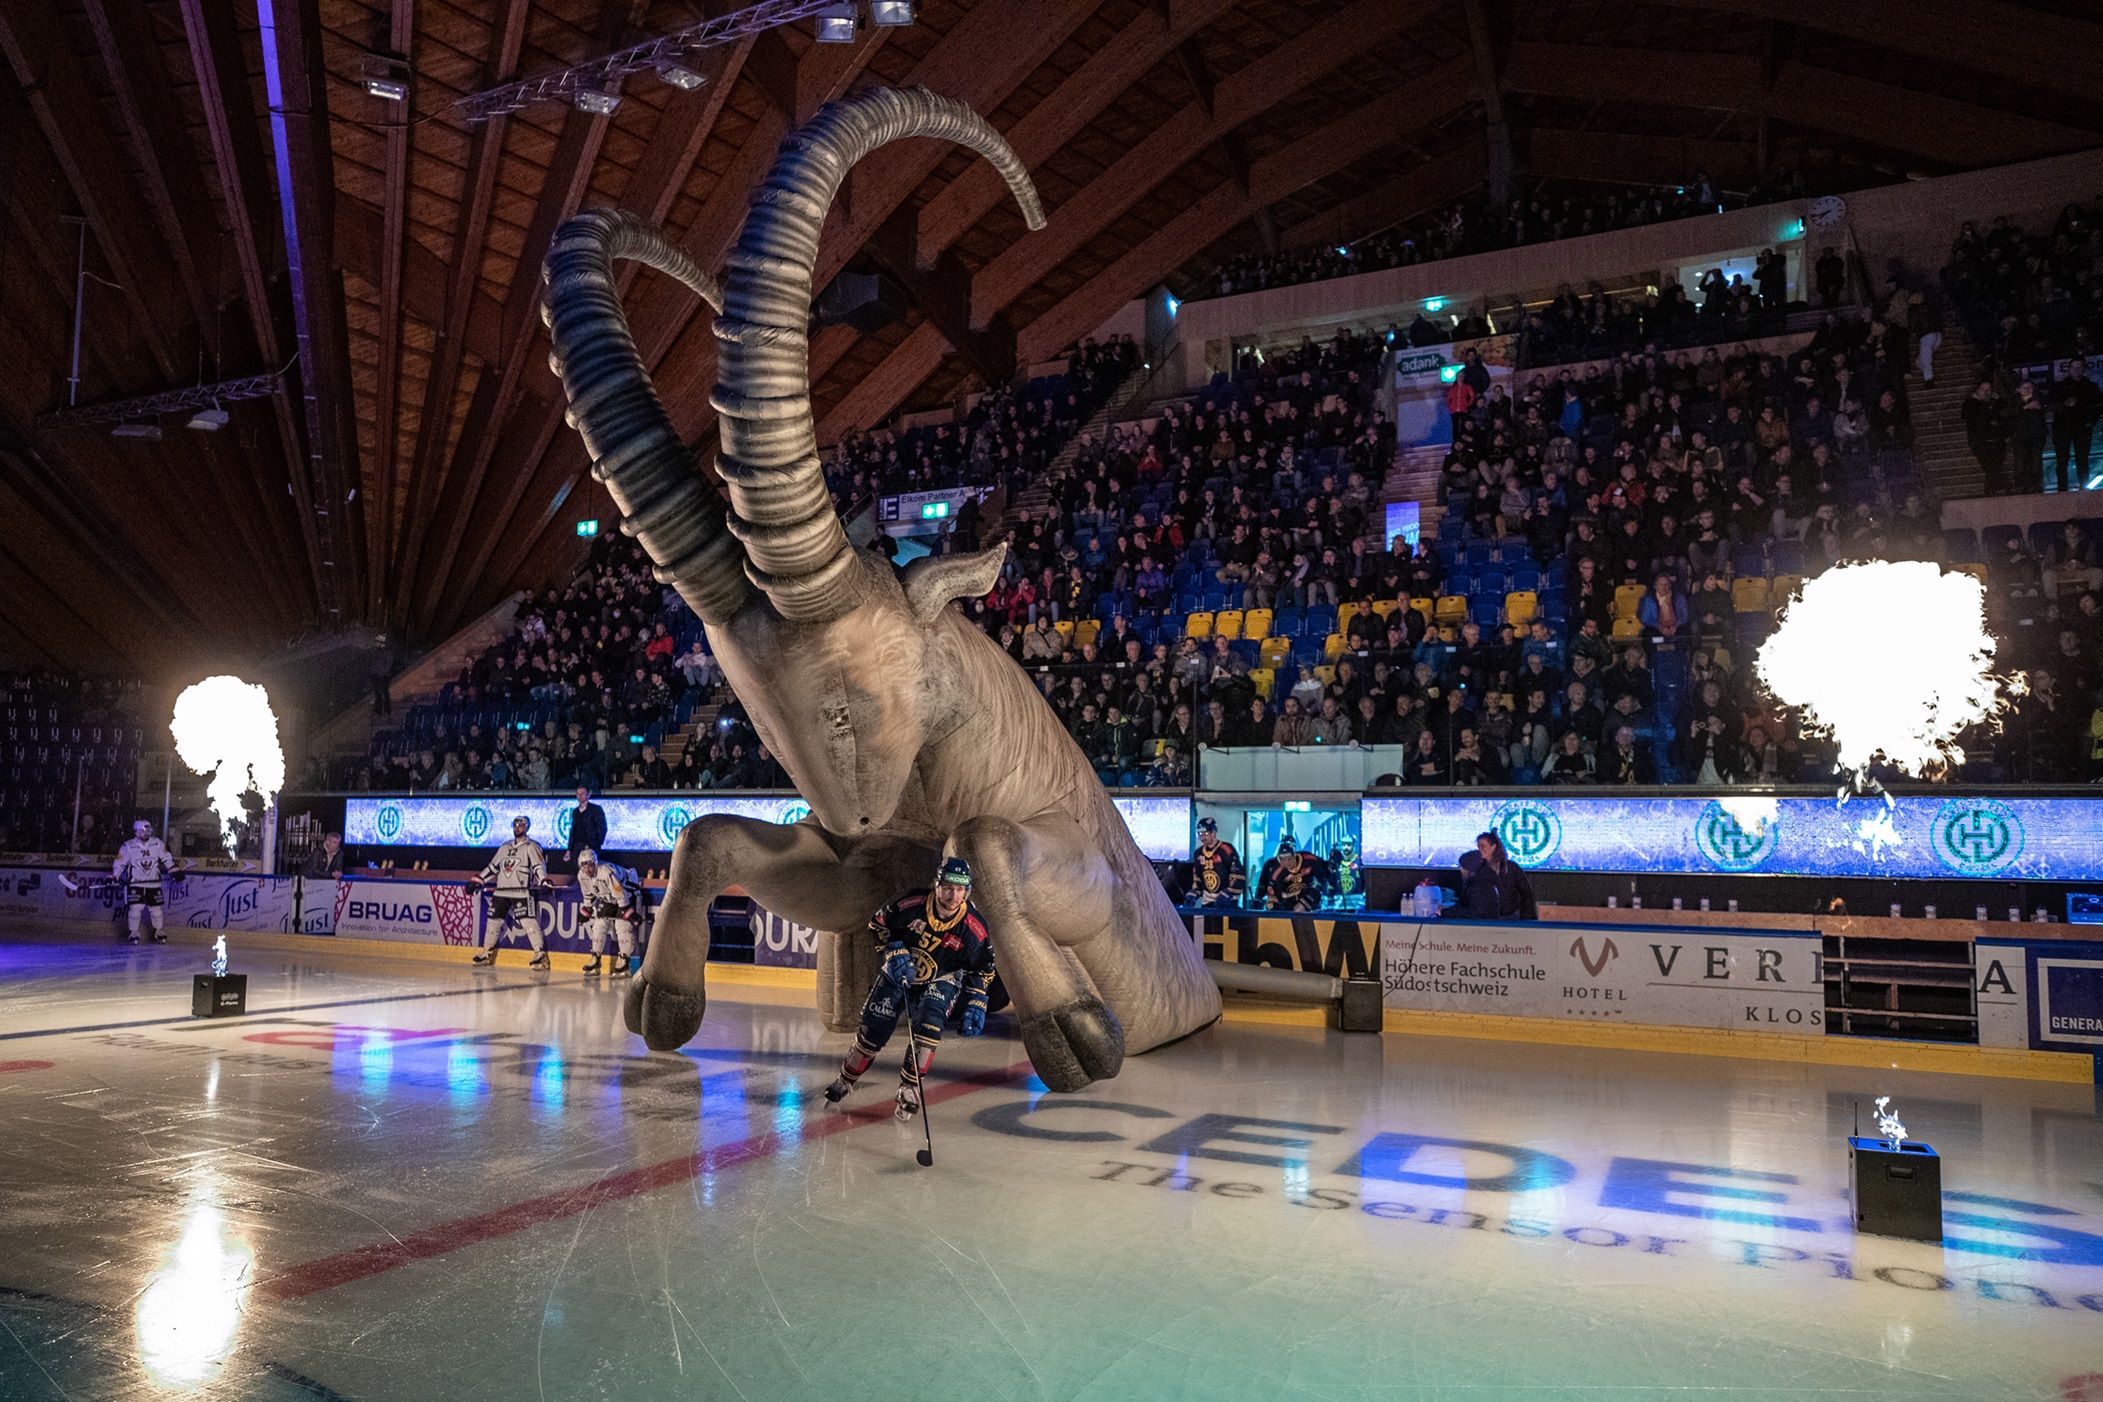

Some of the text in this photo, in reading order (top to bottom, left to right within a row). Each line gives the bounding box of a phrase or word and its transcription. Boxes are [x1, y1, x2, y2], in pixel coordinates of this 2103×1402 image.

[221, 888, 258, 928] Just
[349, 901, 432, 923] BRUAG
[919, 931, 941, 952] 57
[1385, 940, 1537, 956] Meine Schule. Meine Zukunft.
[1385, 959, 1546, 981] Höhere Fachschule
[1563, 987, 1627, 1001] HOTEL
[1090, 1160, 1264, 1198] The
[1289, 1187, 1689, 1257] Sensor
